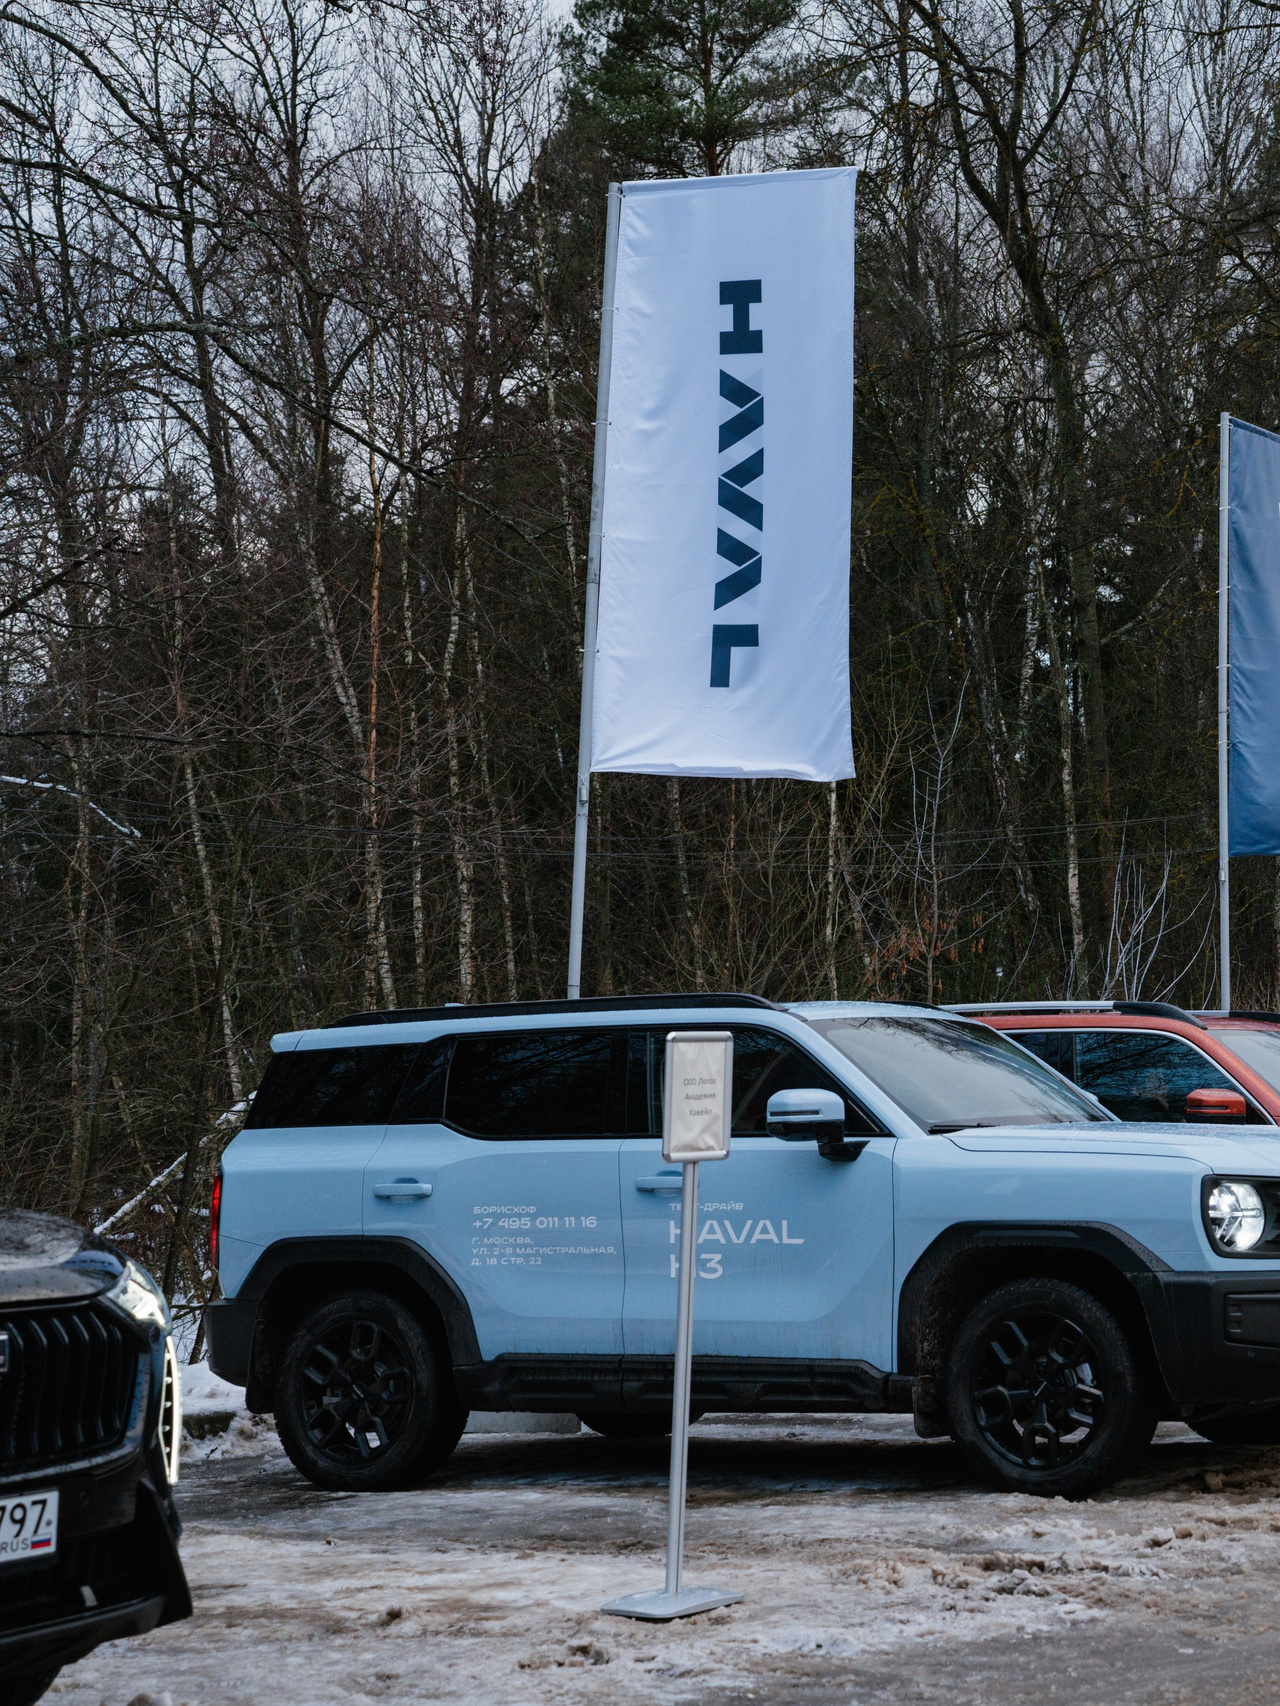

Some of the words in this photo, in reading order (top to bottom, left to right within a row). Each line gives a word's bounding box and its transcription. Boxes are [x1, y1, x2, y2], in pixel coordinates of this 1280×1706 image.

[709, 278, 764, 688] HAVAL
[685, 1093, 716, 1101] Академия
[473, 1206, 536, 1214] БОРИСХОФ
[669, 1201, 744, 1211] ТЕ-ДРАЙВ
[473, 1218, 493, 1229] +7
[498, 1217, 530, 1229] 495
[536, 1217, 558, 1229] 011
[564, 1217, 575, 1228] 11
[580, 1216, 597, 1228] 16
[484, 1236, 534, 1245] МОСКВА,
[516, 1246, 617, 1255] МАГИСТРАЛЬНАЯ,
[471, 1258, 482, 1266] Д.
[501, 1257, 526, 1265] СТР.
[529, 1257, 542, 1265] 22
